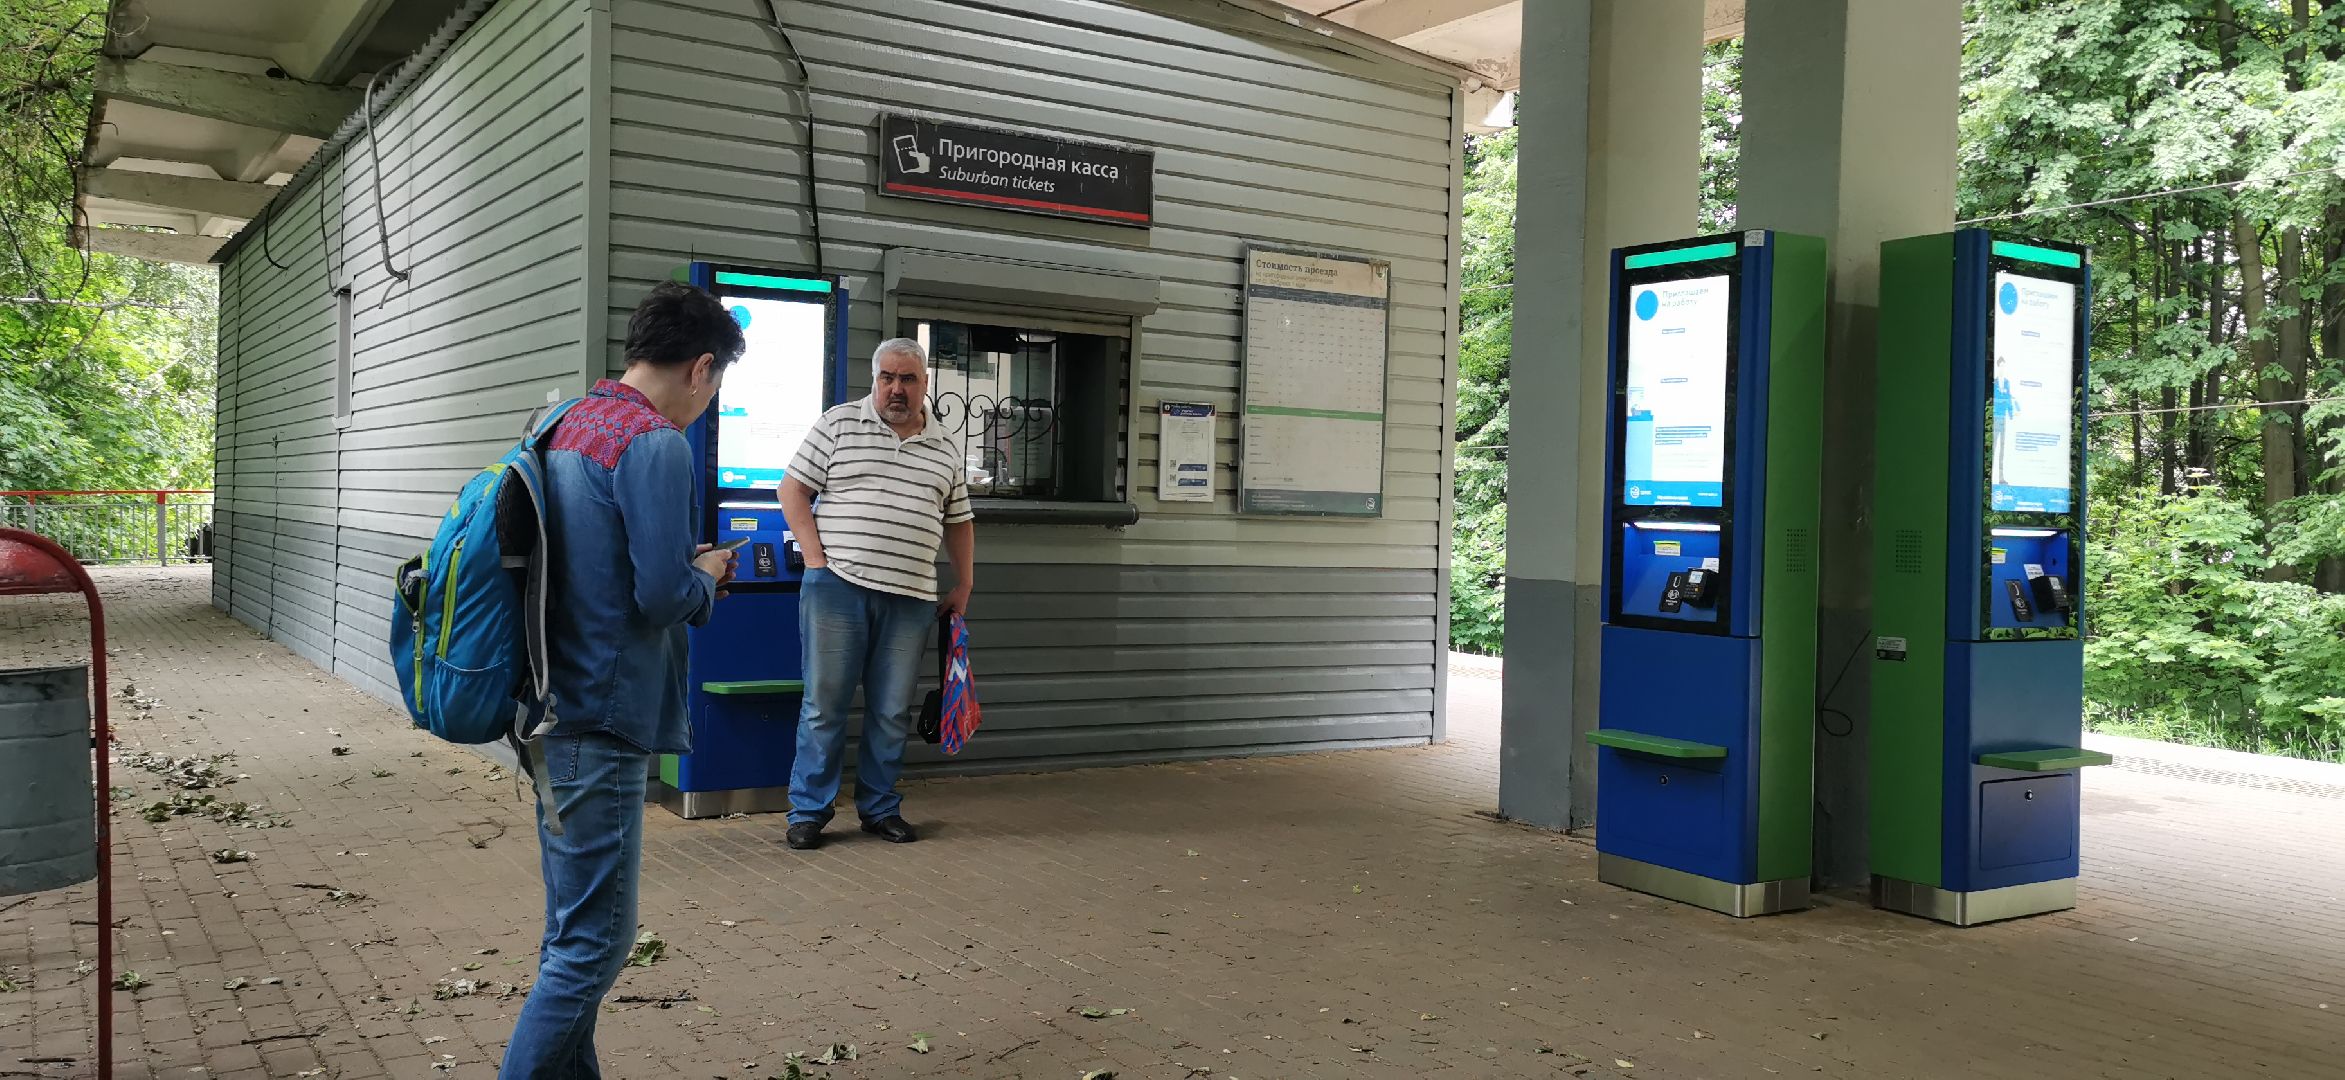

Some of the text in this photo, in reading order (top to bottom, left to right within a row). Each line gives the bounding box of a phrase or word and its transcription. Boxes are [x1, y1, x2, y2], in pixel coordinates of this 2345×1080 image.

[939, 138, 1119, 179] Пригородная касса
[938, 166, 1056, 193] Suburban tickets
[1256, 259, 1338, 277] Стоимость проезда
